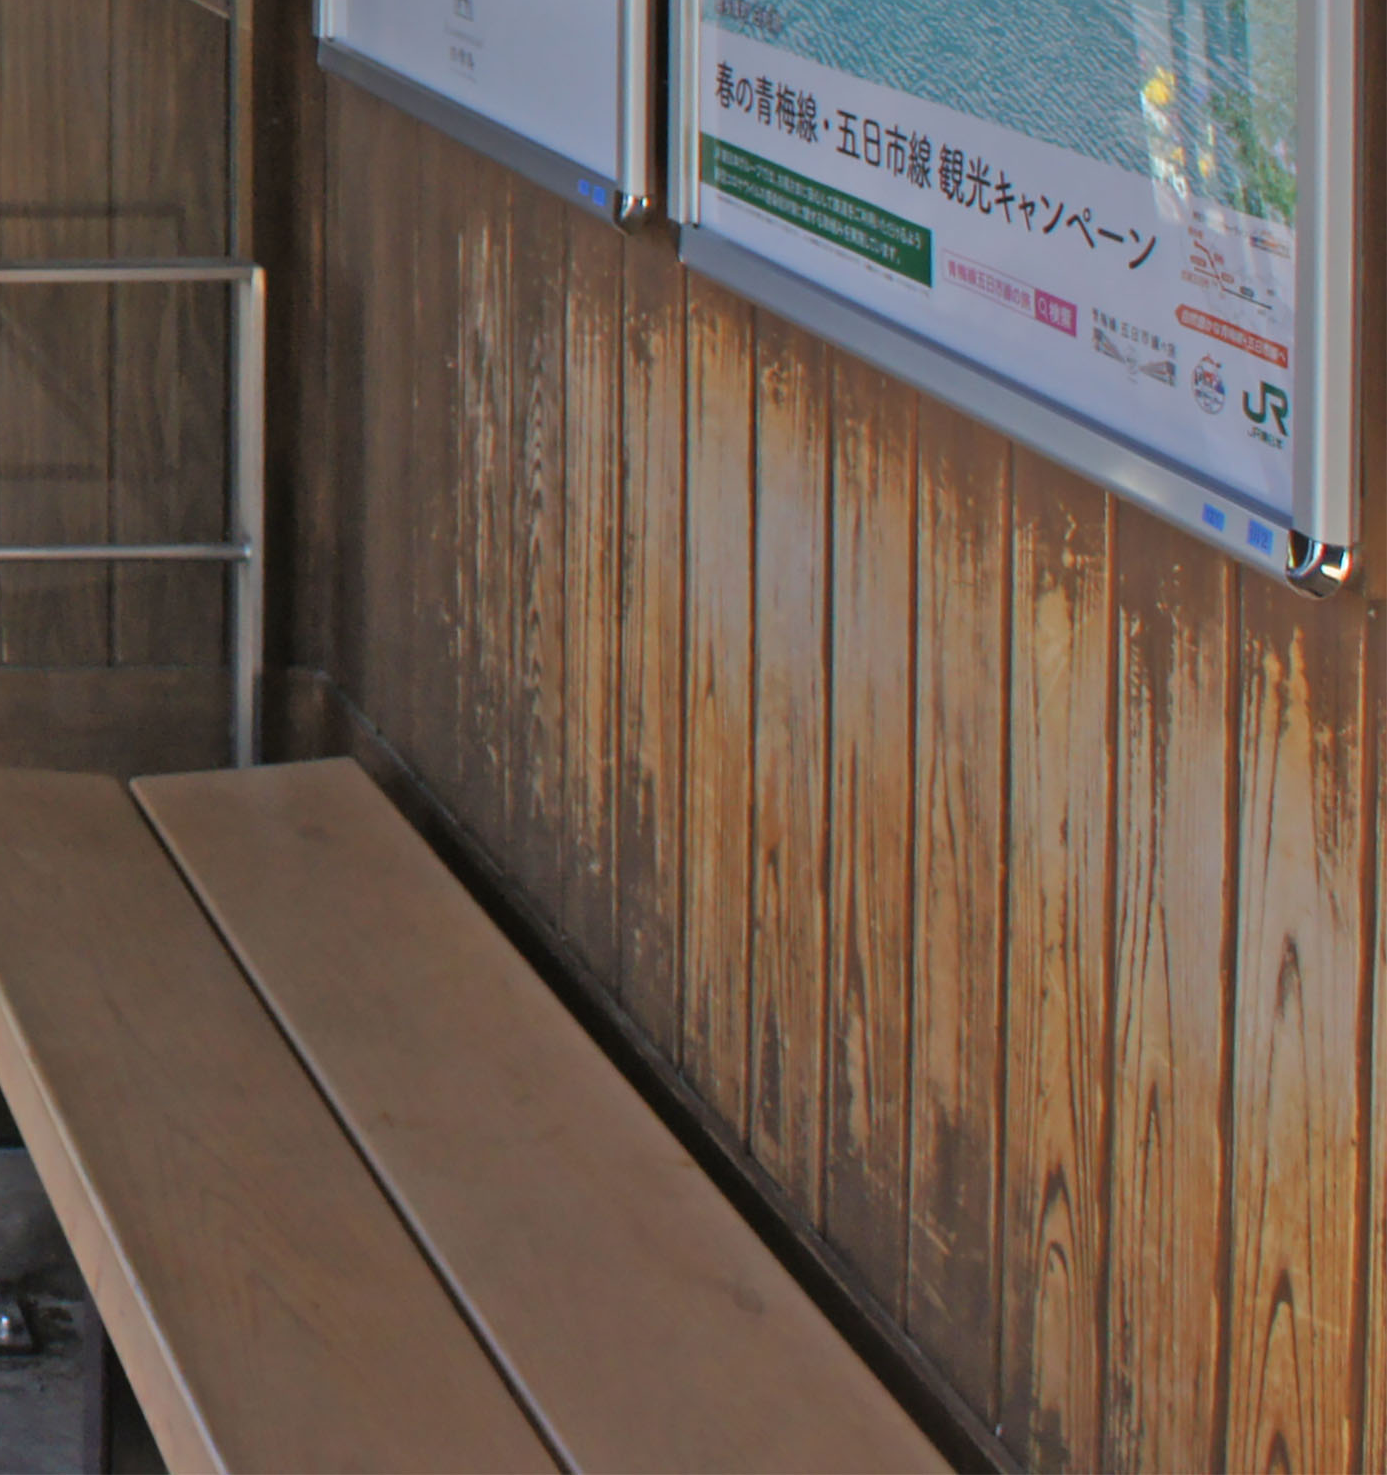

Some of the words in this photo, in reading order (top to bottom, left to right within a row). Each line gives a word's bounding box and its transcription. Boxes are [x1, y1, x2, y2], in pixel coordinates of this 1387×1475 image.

[714, 60, 934, 193] 春の青梅線・五日市線
[937, 141, 1158, 272] 観光キャンペーン
[1242, 380, 1290, 438] JR
